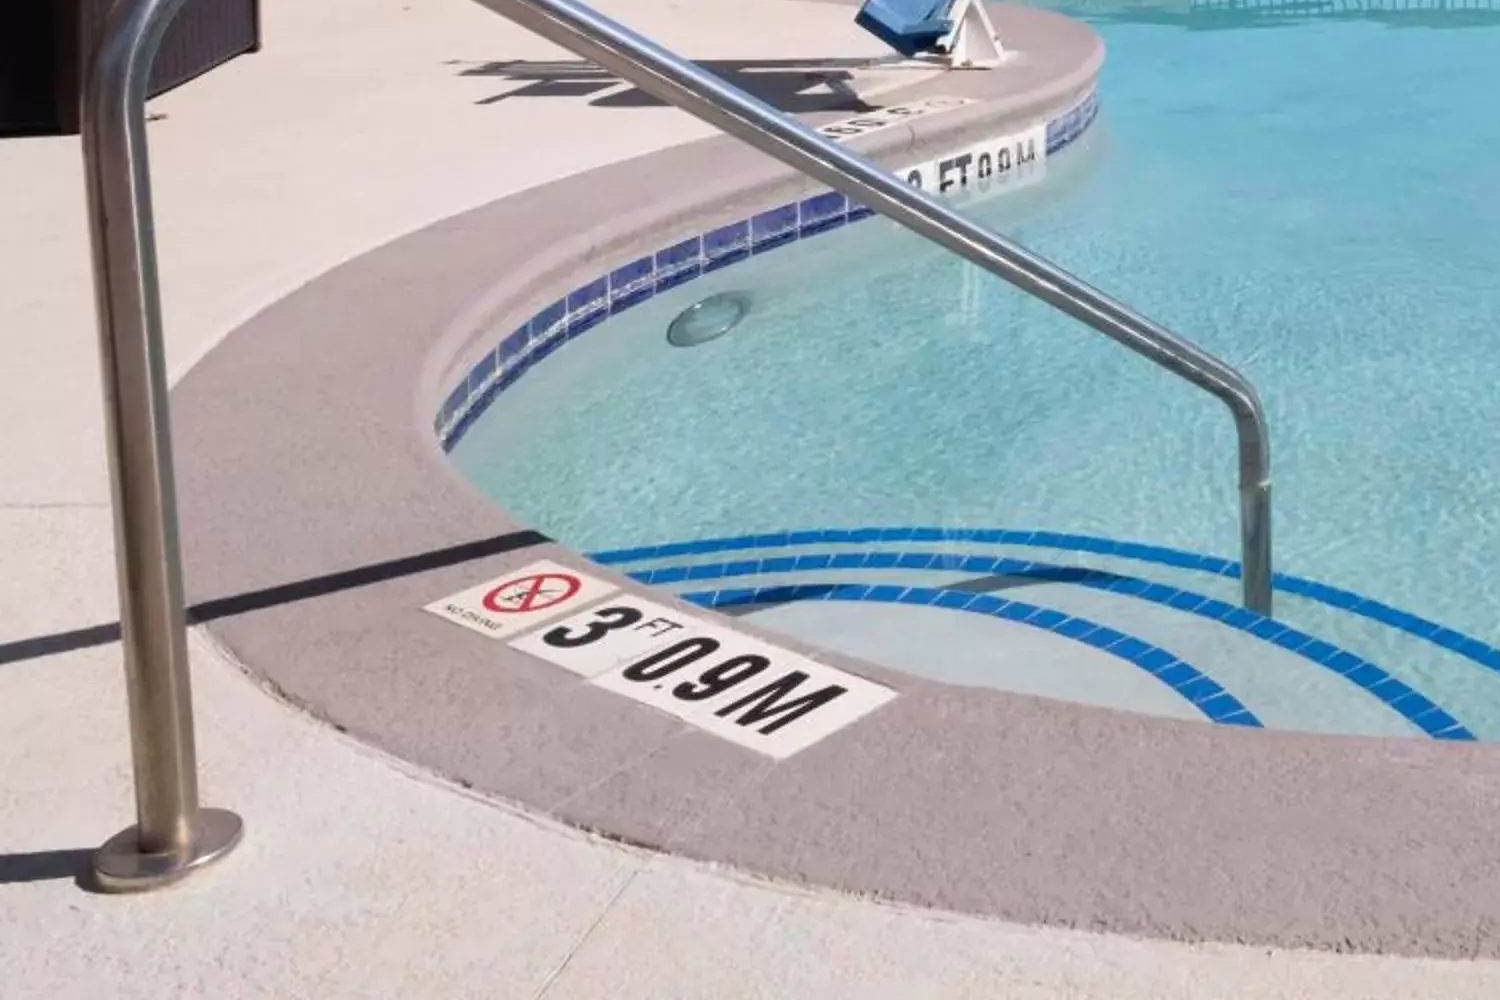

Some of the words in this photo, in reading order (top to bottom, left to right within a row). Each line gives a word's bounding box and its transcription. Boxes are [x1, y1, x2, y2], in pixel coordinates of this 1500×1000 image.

[543, 606, 644, 649] 3
[634, 616, 685, 638] FT
[622, 636, 849, 736] 0.9M
